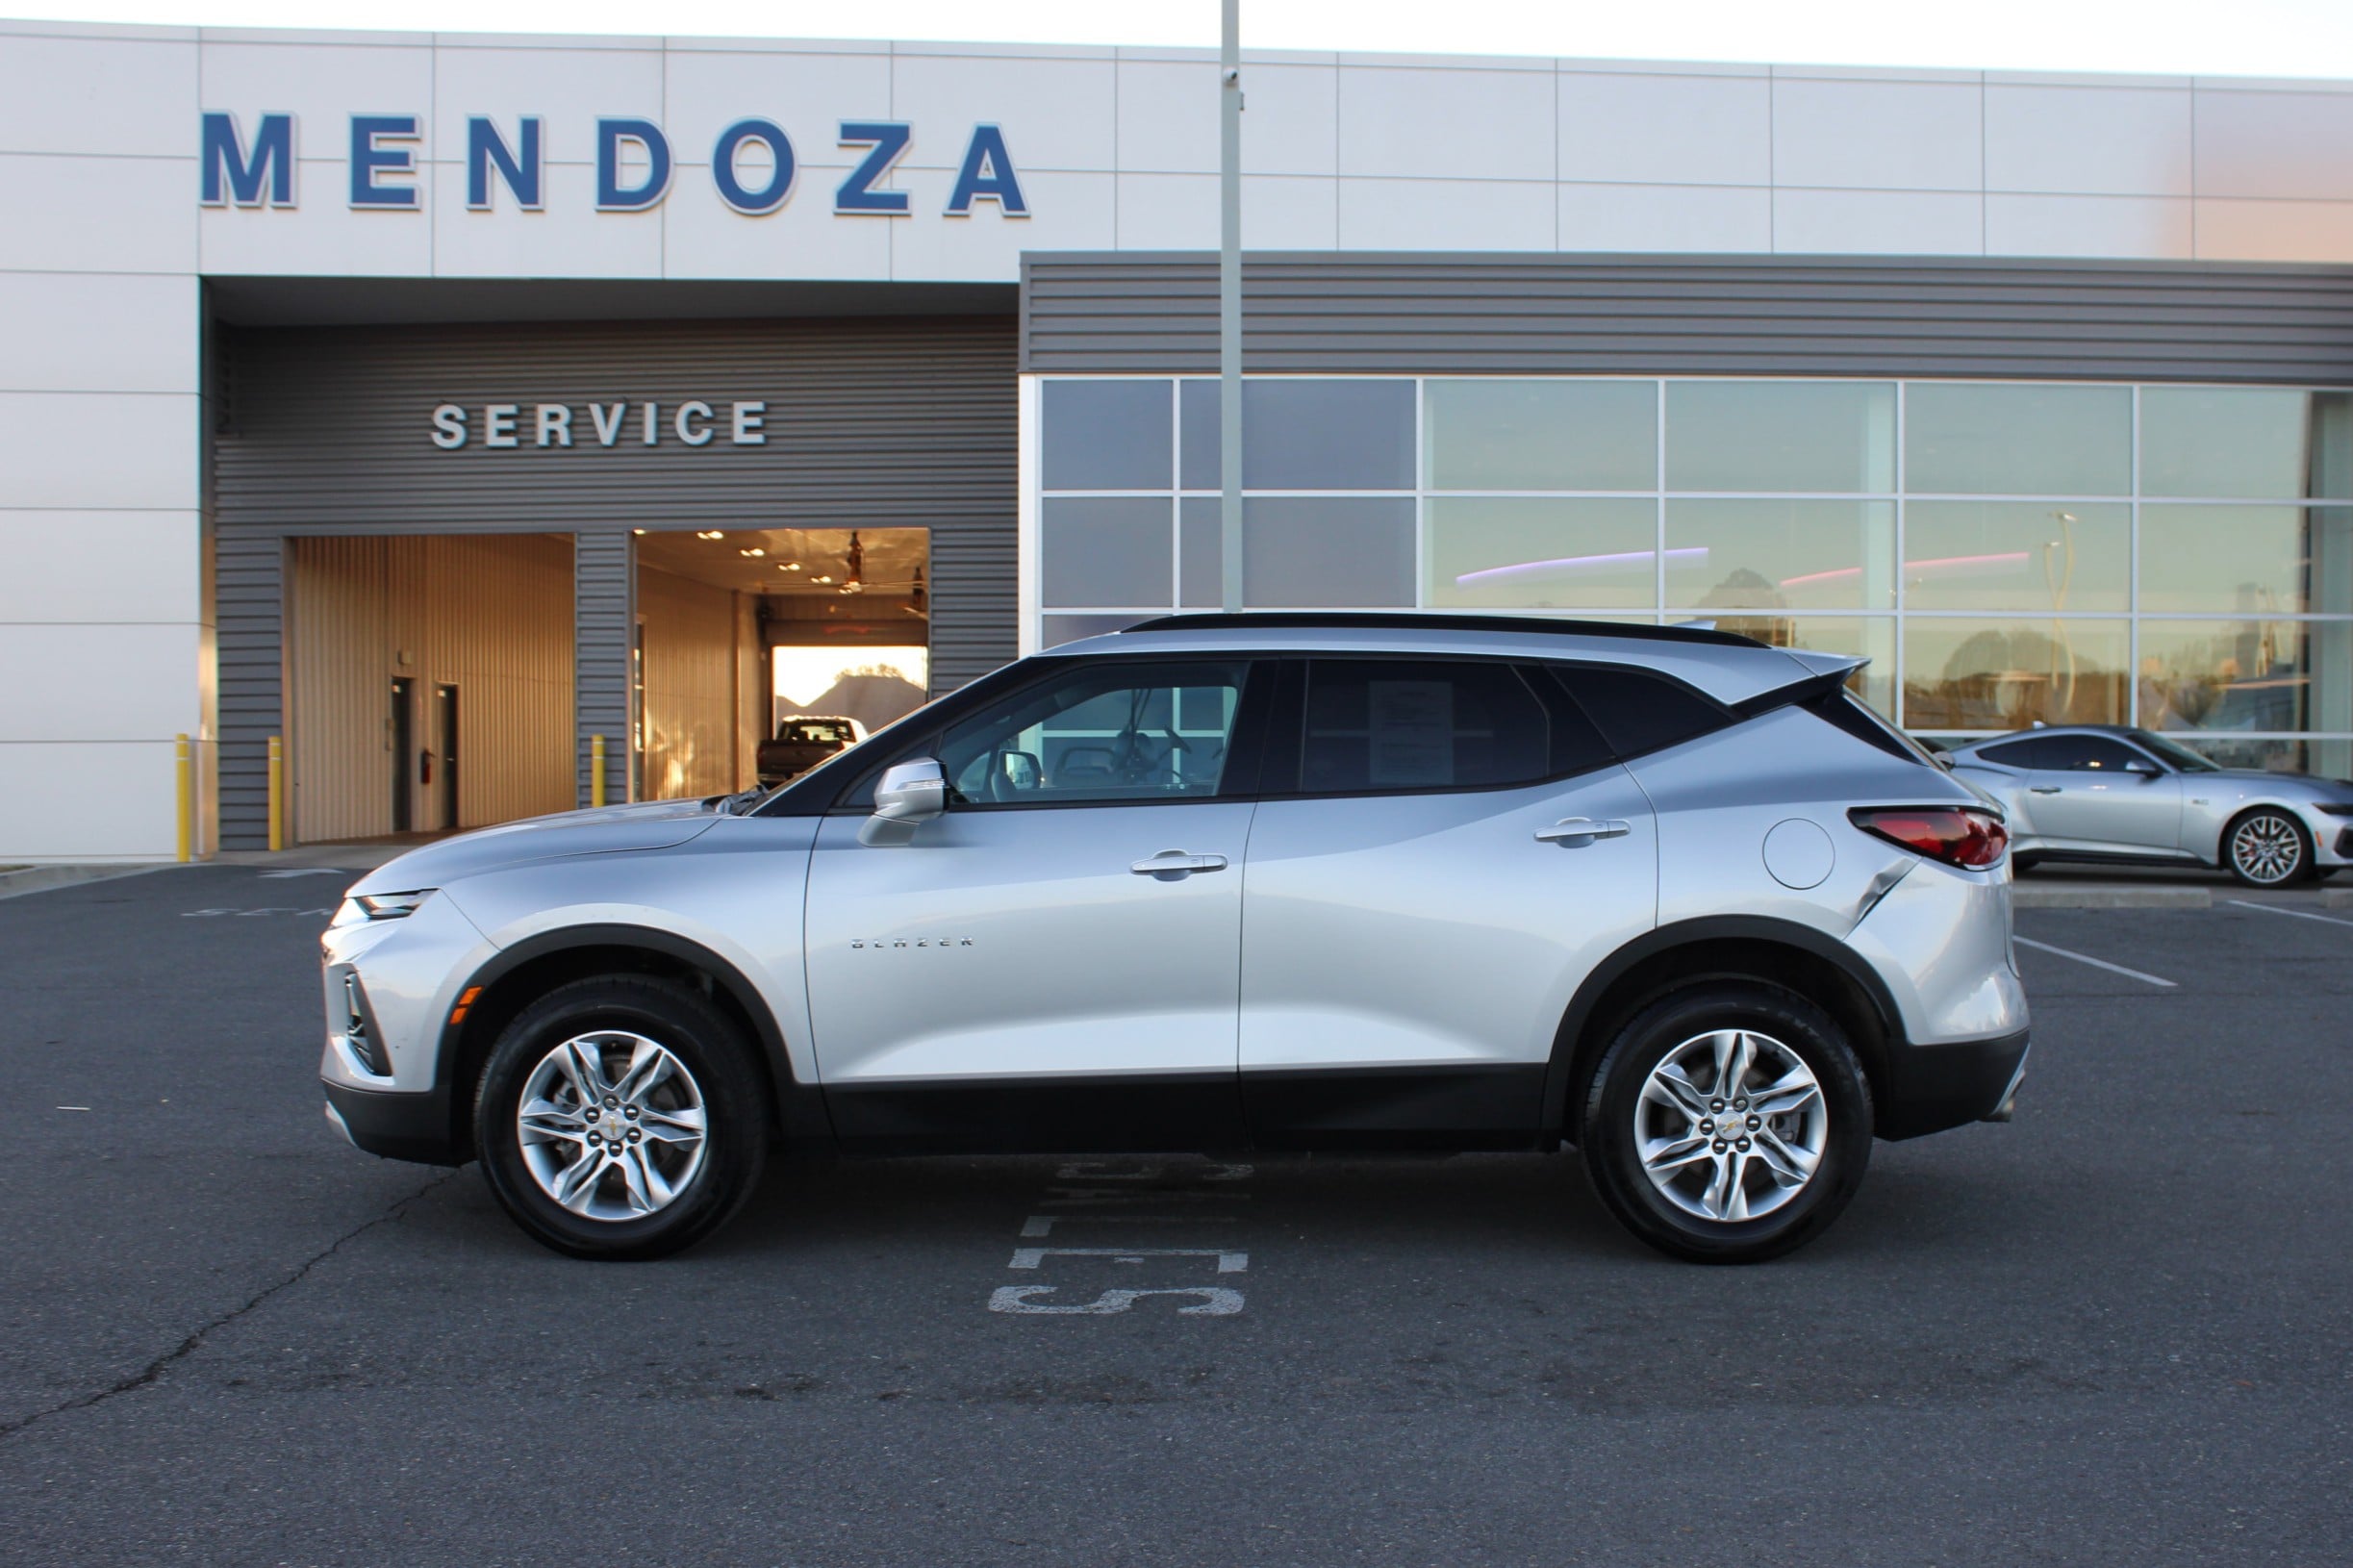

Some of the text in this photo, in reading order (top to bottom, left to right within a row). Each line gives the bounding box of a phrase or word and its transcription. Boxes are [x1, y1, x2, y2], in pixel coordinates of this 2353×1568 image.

[199, 112, 1030, 217] MENDOZA
[431, 400, 769, 449] SERVICE
[851, 938, 973, 948] BLAZER
